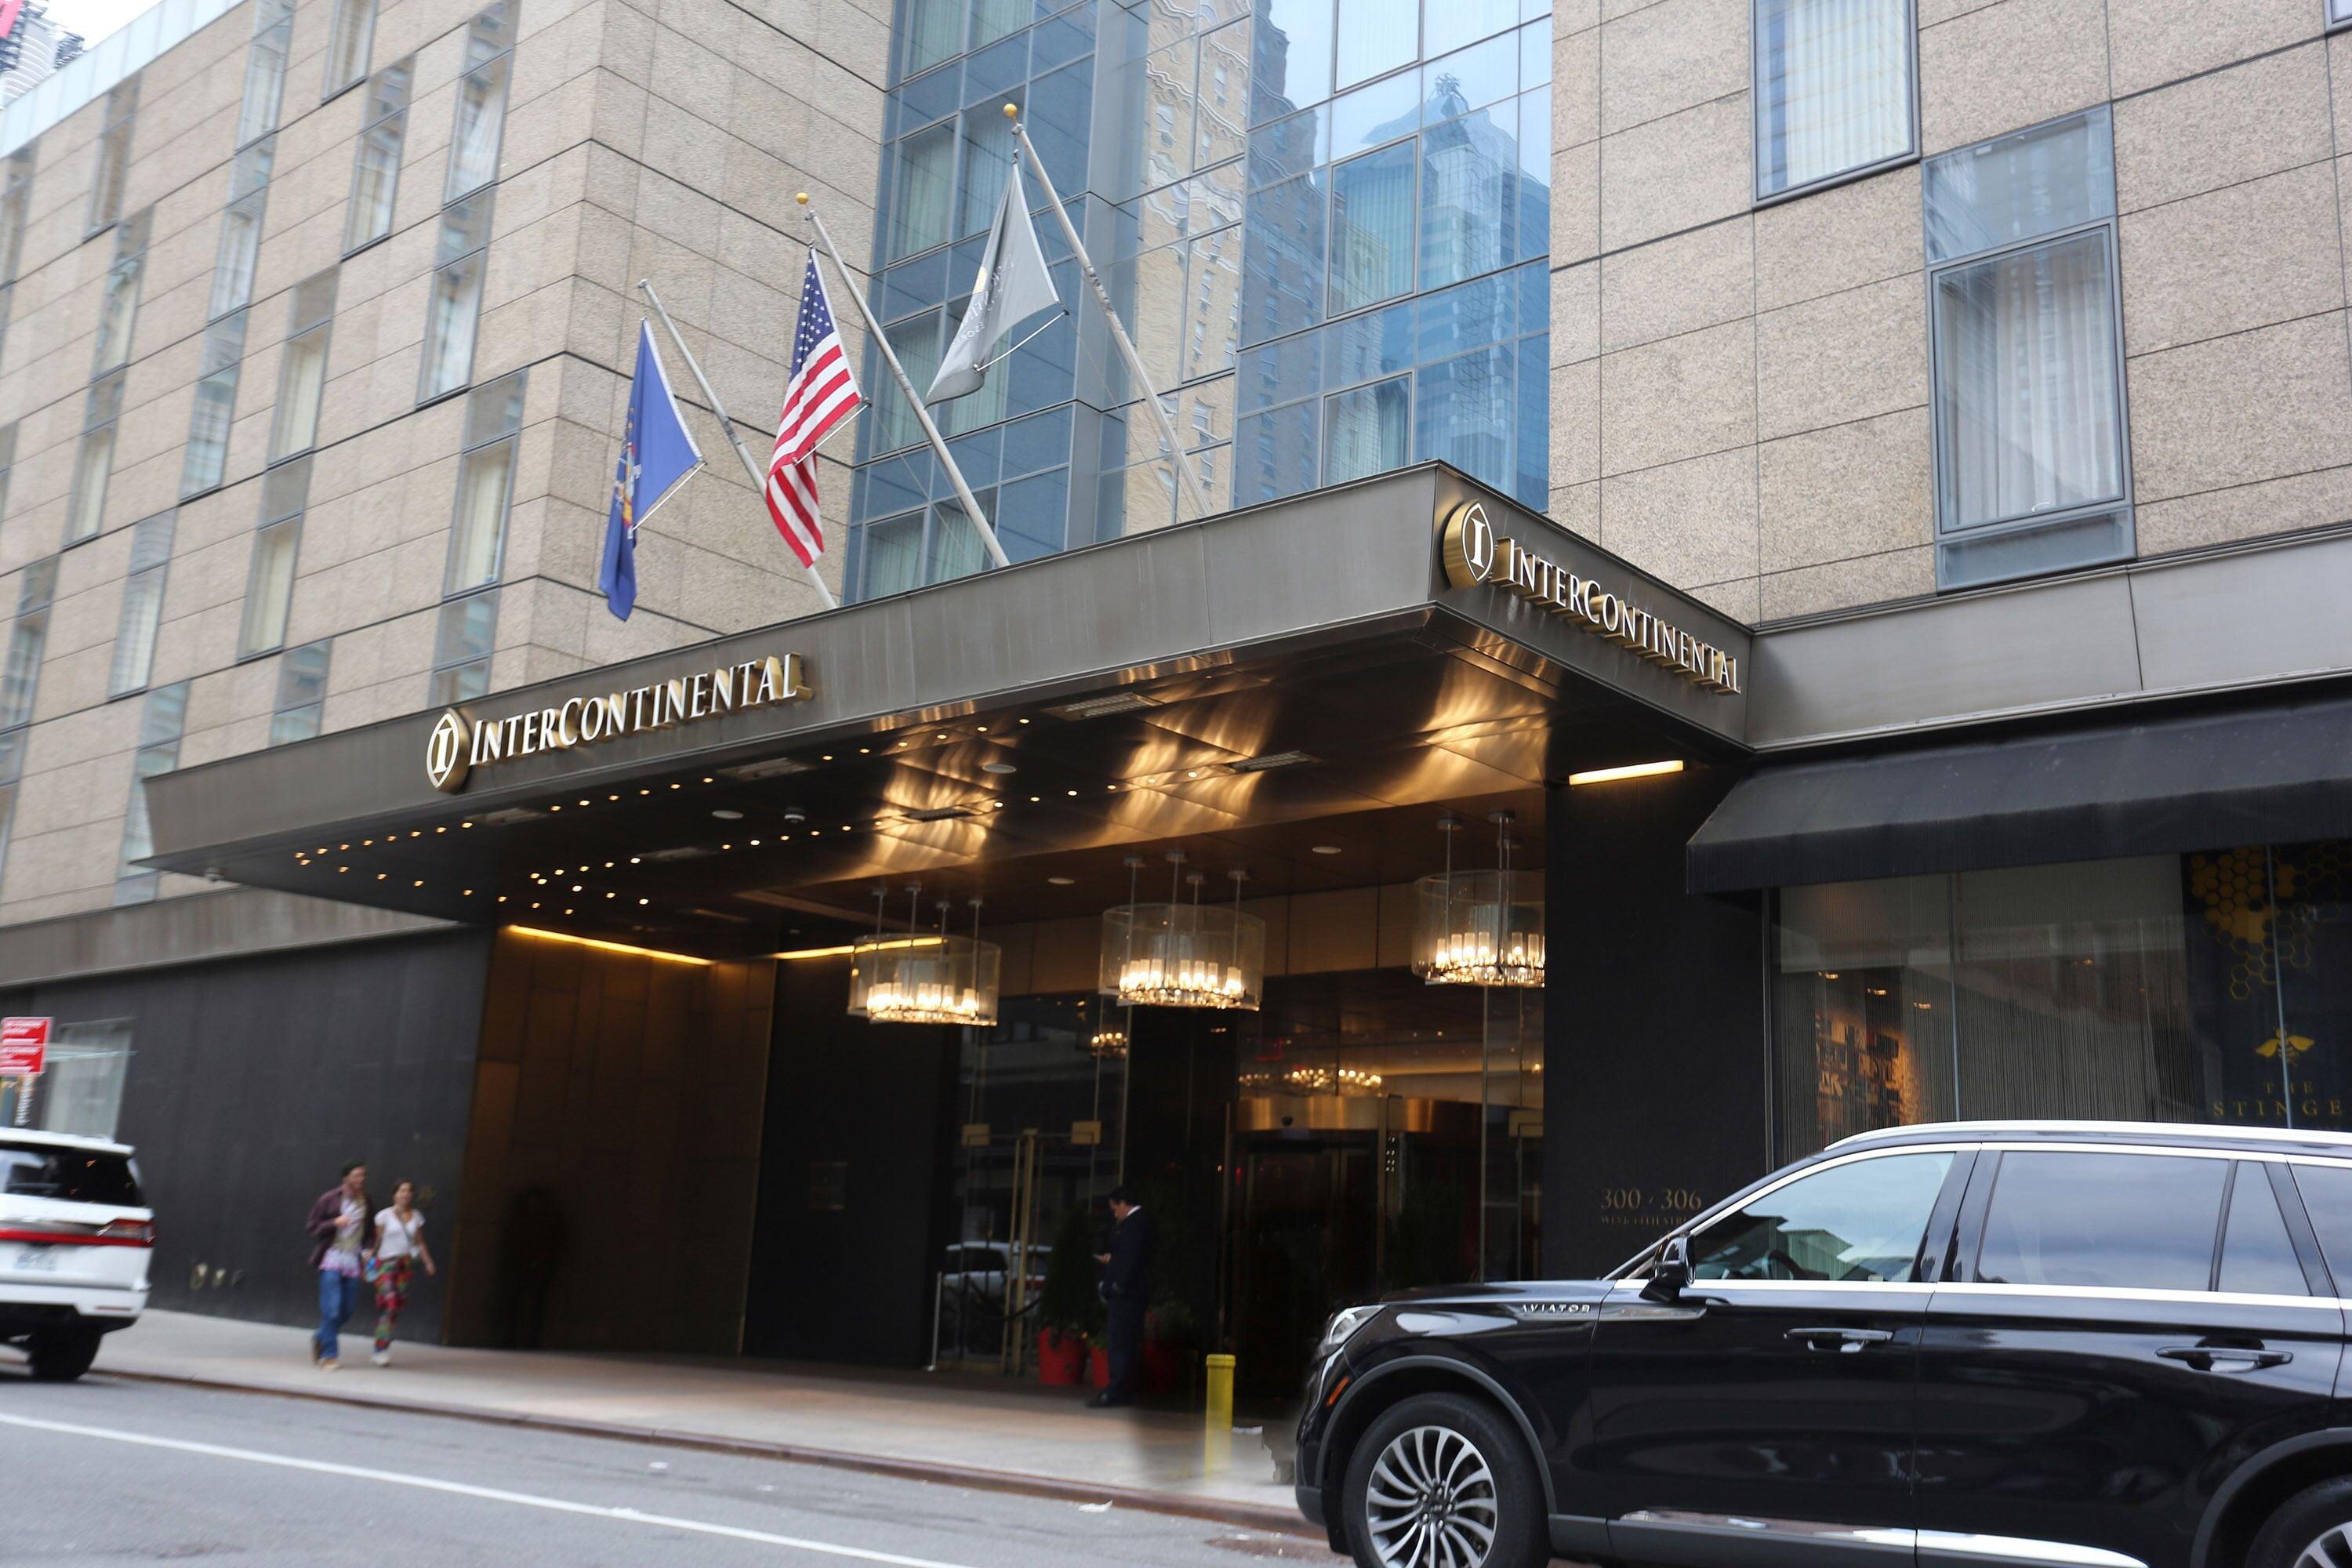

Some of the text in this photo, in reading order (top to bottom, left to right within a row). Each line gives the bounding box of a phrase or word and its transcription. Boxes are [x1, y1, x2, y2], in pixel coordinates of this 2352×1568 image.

[1492, 535, 1741, 695] INTERCONTINENTAL
[469, 652, 813, 768] INTERCONTINENTAL
[1600, 1187, 1703, 1211] 300 306
[1523, 1304, 1591, 1313] AVIATOR
